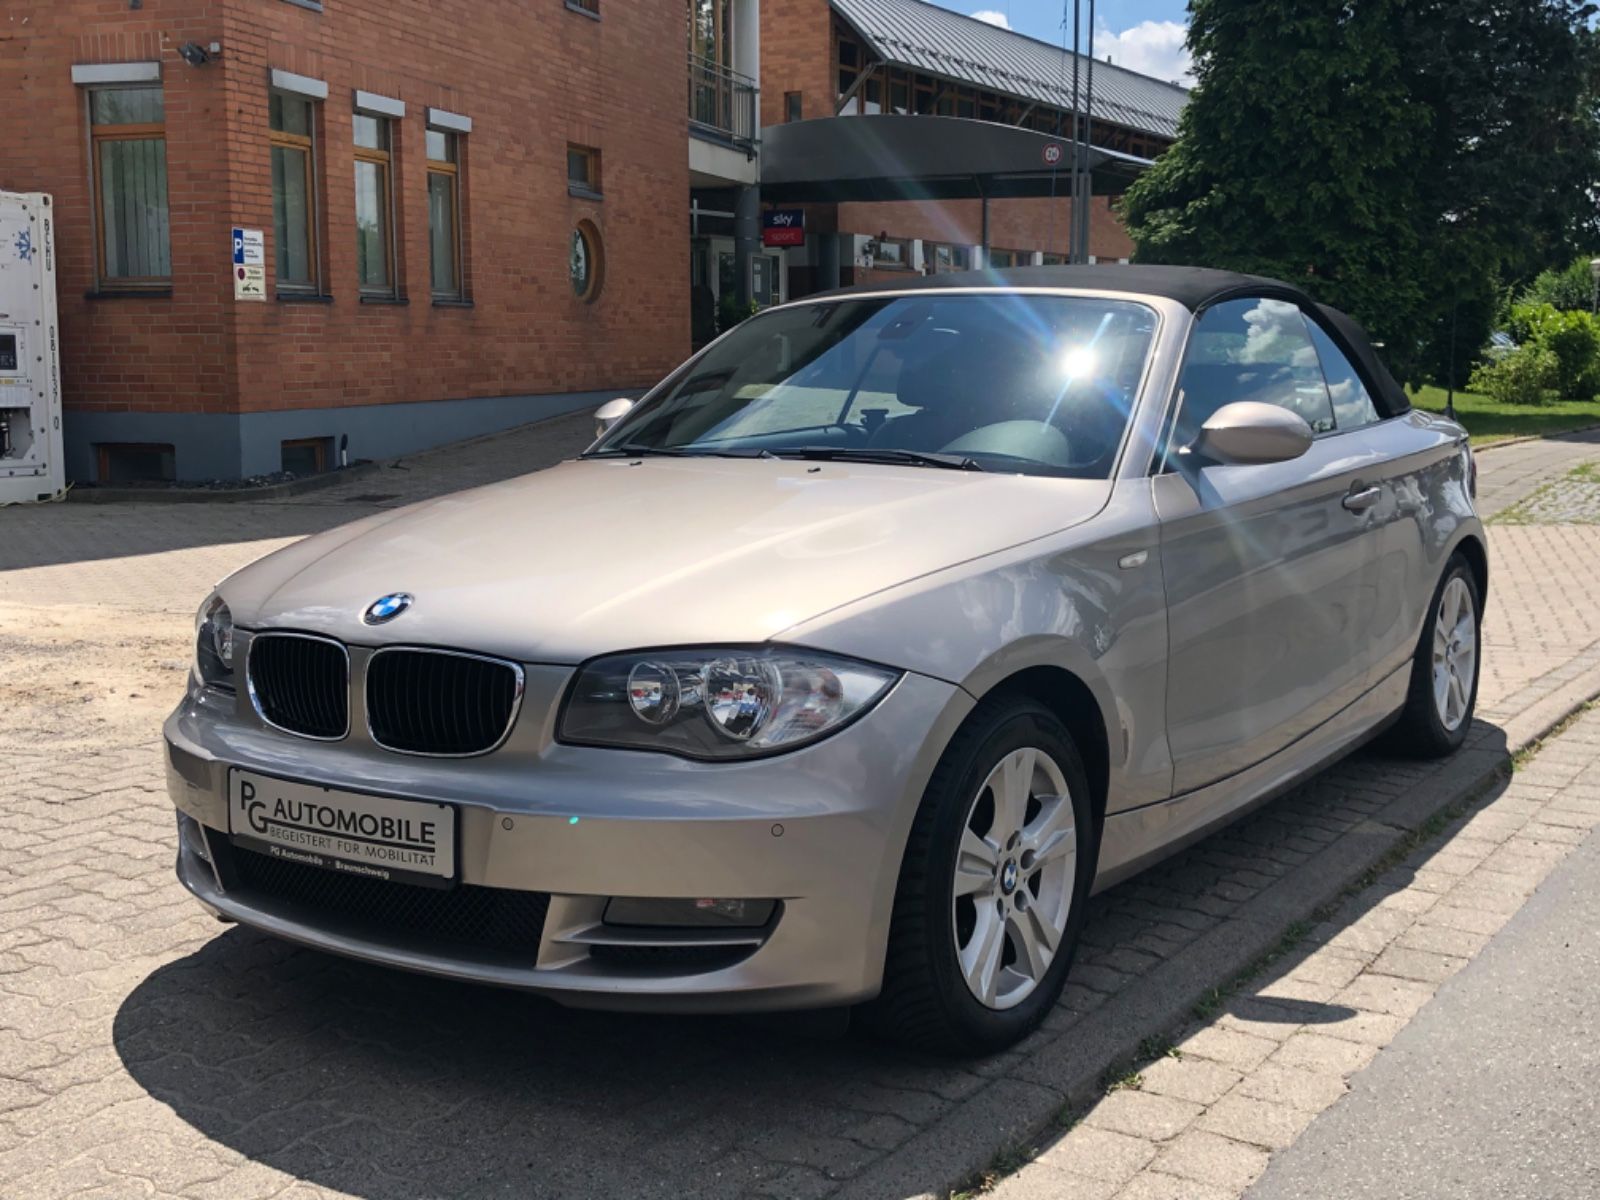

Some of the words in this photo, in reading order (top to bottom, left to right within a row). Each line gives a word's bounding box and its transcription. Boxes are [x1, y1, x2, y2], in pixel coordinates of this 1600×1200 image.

[772, 213, 793, 227] sky
[234, 238, 242, 254] P
[771, 232, 796, 242] sport
[273, 798, 435, 844] AUTOMOBILE
[270, 826, 331, 849] BEGEISTERT
[337, 840, 360, 855] FÜR
[365, 845, 436, 866] MOBILITÄT
[281, 848, 323, 865] Automobile
[335, 860, 390, 880] Braunschweig
